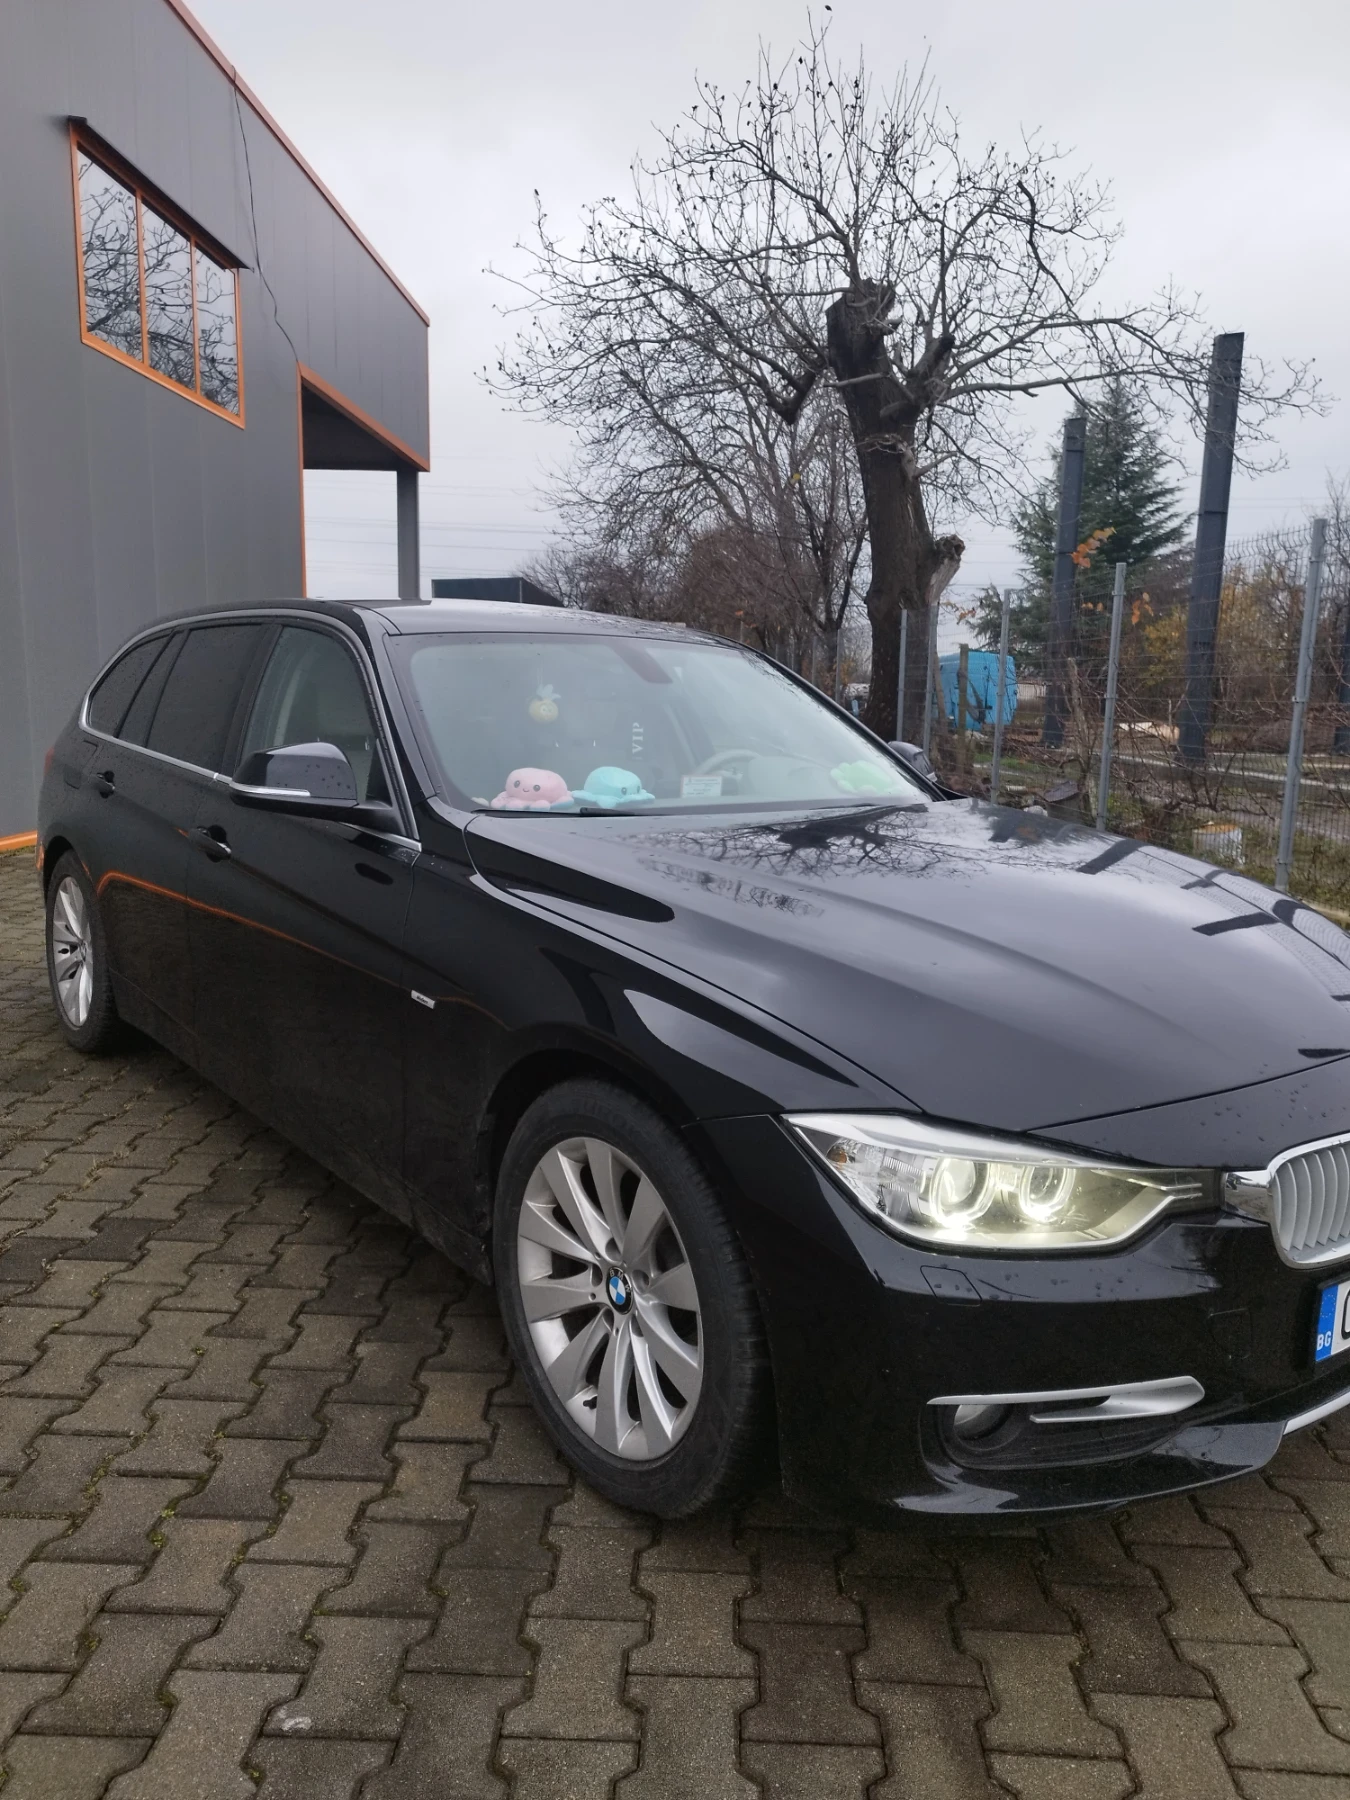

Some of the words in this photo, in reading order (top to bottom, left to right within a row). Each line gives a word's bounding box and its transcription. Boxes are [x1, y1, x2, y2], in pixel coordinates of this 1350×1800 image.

[632, 722, 643, 754] VIP
[610, 1268, 631, 1293] BMW
[1316, 1331, 1332, 1351] BG
